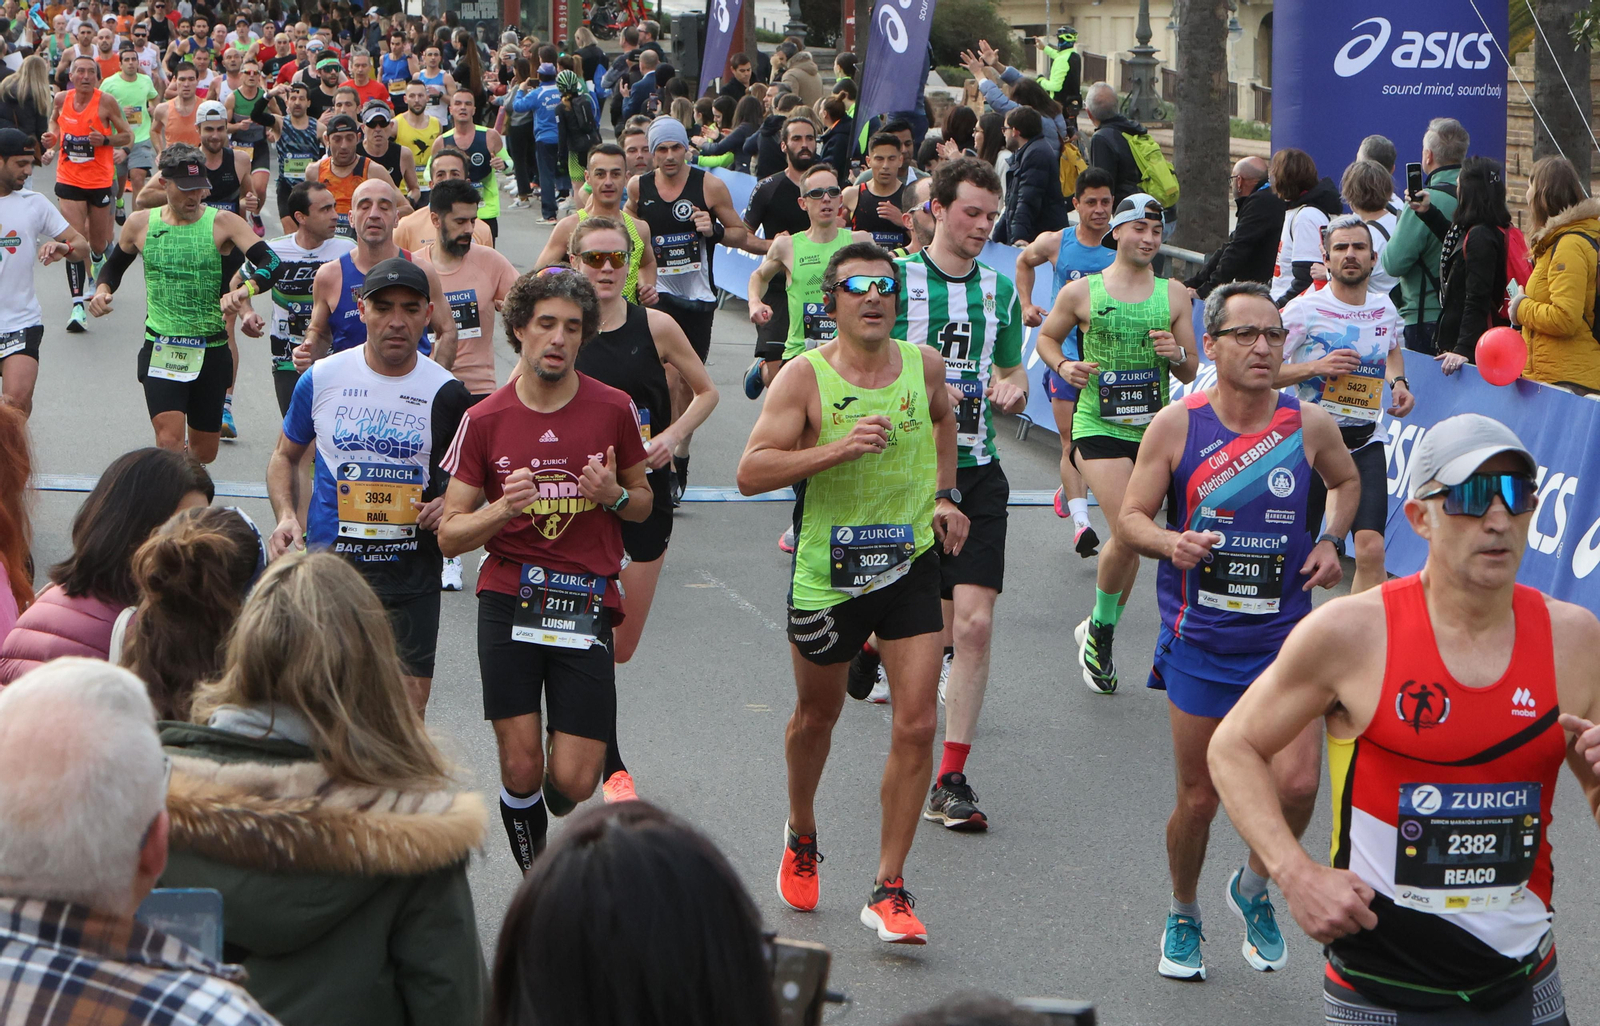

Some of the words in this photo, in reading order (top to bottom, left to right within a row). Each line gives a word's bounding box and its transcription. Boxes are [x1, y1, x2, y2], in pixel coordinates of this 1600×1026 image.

[1391, 31, 1492, 70] asics
[1382, 82, 1422, 95] sound
[1424, 82, 1454, 97] mind,
[1457, 84, 1486, 96] sound
[1486, 84, 1502, 99] body
[668, 248, 685, 256] 3006
[445, 292, 470, 302] URICH
[172, 336, 200, 346] ZURICH
[171, 352, 188, 360] 1767
[1353, 364, 1380, 374] URICH
[1120, 371, 1154, 380] ZURICH
[1347, 382, 1367, 392] 5423
[1120, 391, 1142, 400] 3146
[1338, 395, 1369, 406] CARLITOS
[1116, 405, 1148, 414] ROSENDE
[335, 406, 426, 430] RUNNERS
[336, 419, 350, 440] la
[356, 414, 422, 443] Palmera
[1196, 467, 1234, 500] Atletismo
[1233, 430, 1283, 472] LEBRIJA
[1208, 450, 1229, 470] Club
[366, 468, 413, 480] ZURICH
[365, 492, 392, 504] 3934
[367, 510, 388, 522] RAÚL
[860, 528, 905, 540] ZURICH
[336, 542, 362, 553] BAR
[366, 540, 418, 552] PATRÓN
[1232, 536, 1280, 548] ZURICH
[860, 554, 888, 566] 3022
[1228, 562, 1260, 576] 2210
[551, 573, 596, 588] ZURICH
[1228, 584, 1258, 596] DAVID
[546, 598, 574, 612] 2111
[542, 618, 576, 630] LUISMI
[1512, 709, 1536, 717] mobel
[1452, 790, 1528, 808] ZURICH
[1448, 834, 1497, 854] 2382
[1444, 868, 1496, 885] REACO
[1411, 894, 1430, 903] asics
